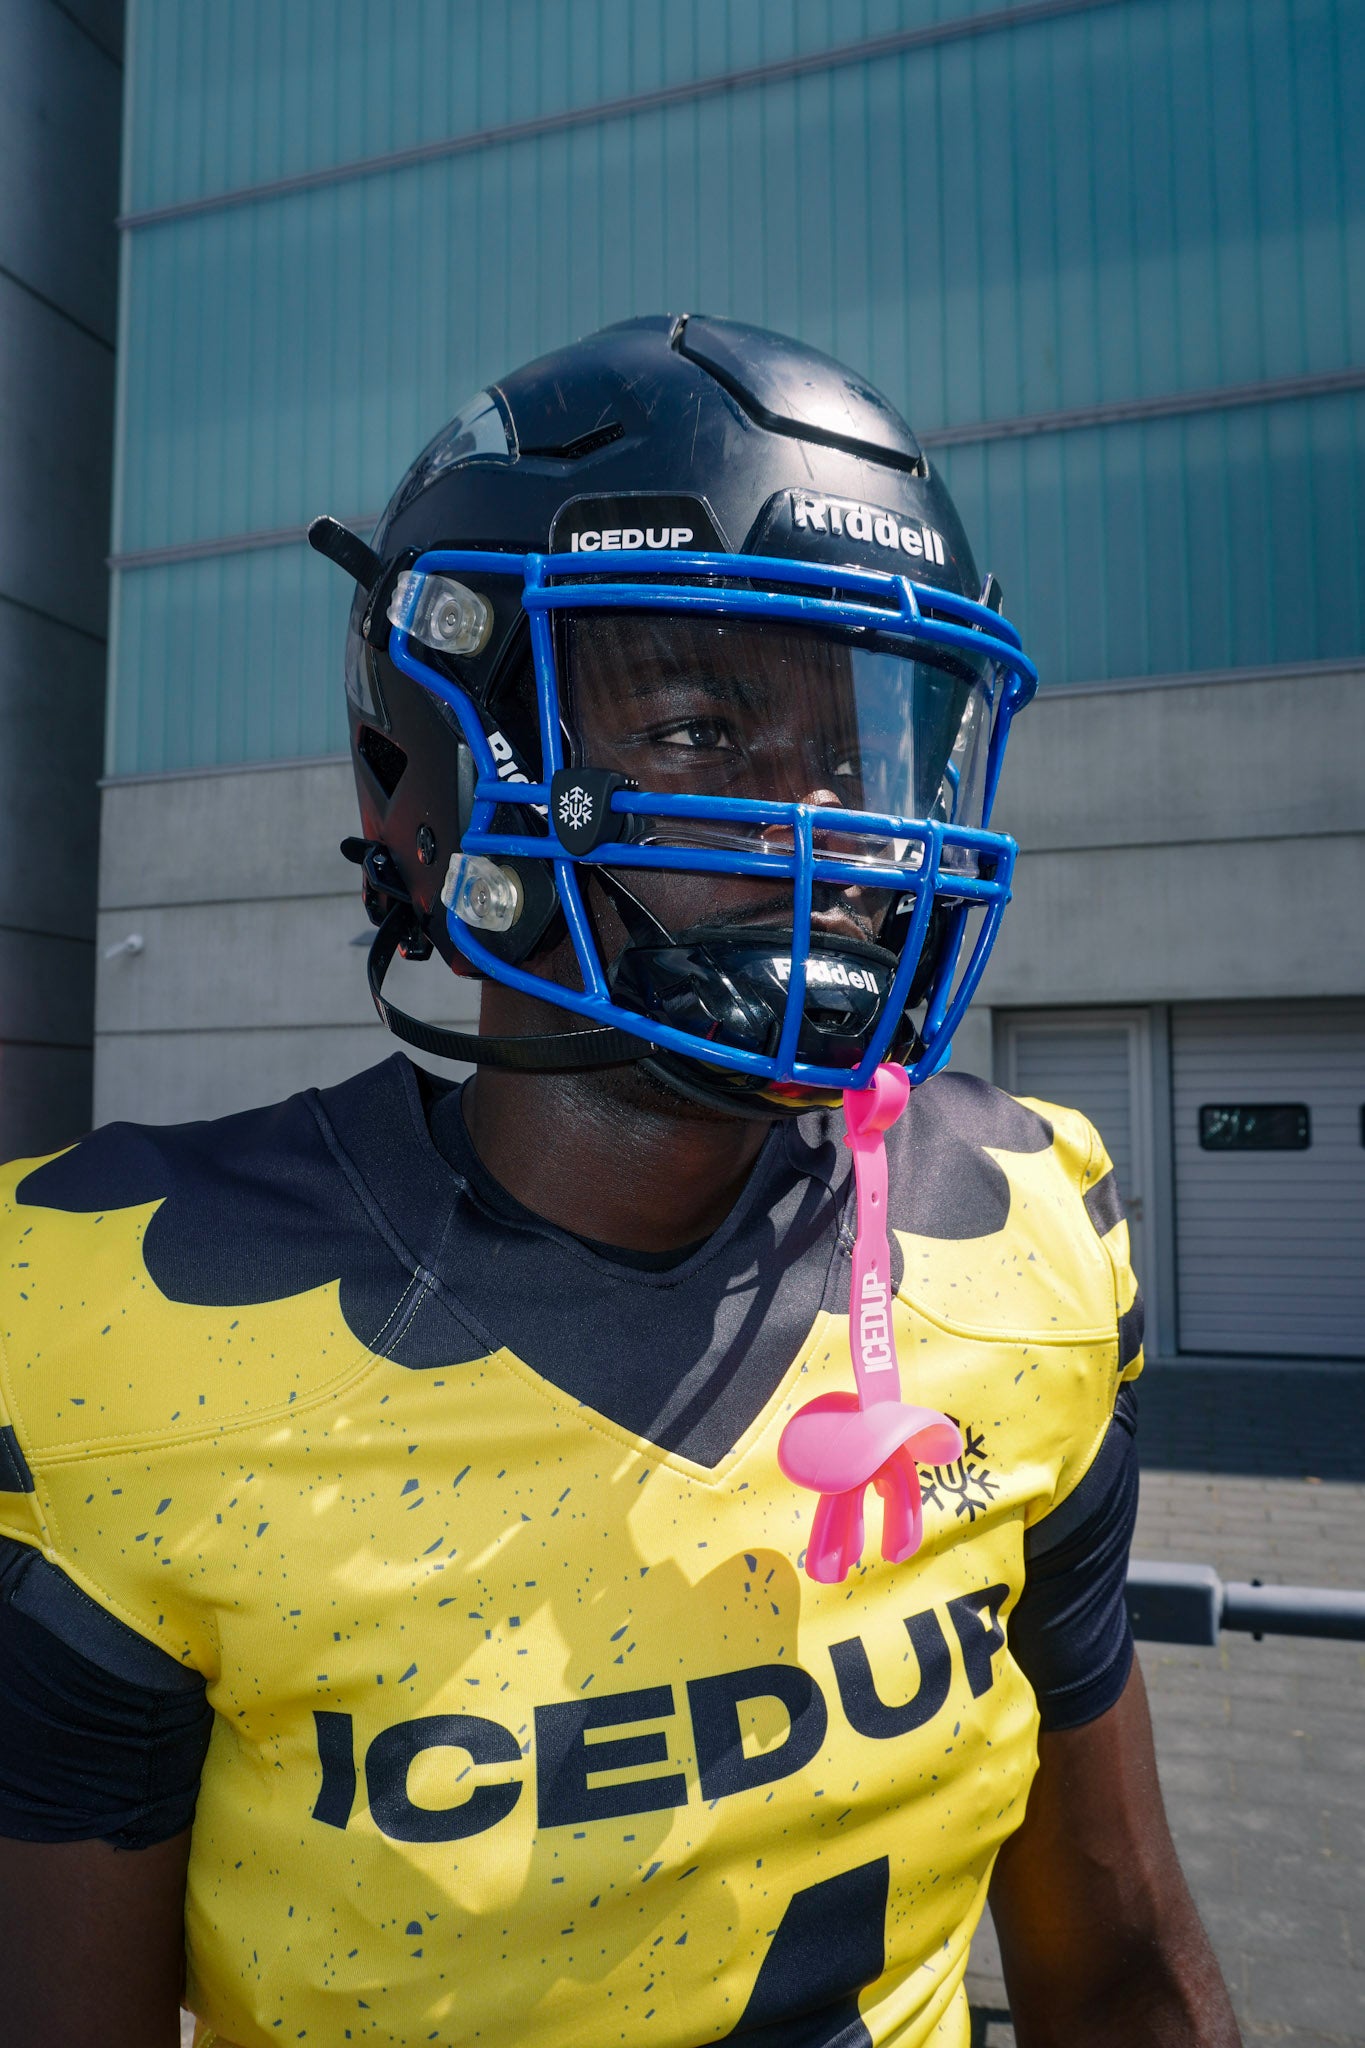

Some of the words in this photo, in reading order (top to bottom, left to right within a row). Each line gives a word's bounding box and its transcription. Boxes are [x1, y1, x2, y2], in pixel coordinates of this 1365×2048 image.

[571, 528, 694, 552] ICEDUP
[792, 495, 945, 566] Riddell
[860, 1271, 893, 1374] ICEDUP
[311, 1582, 1011, 1843] ICEDUP
